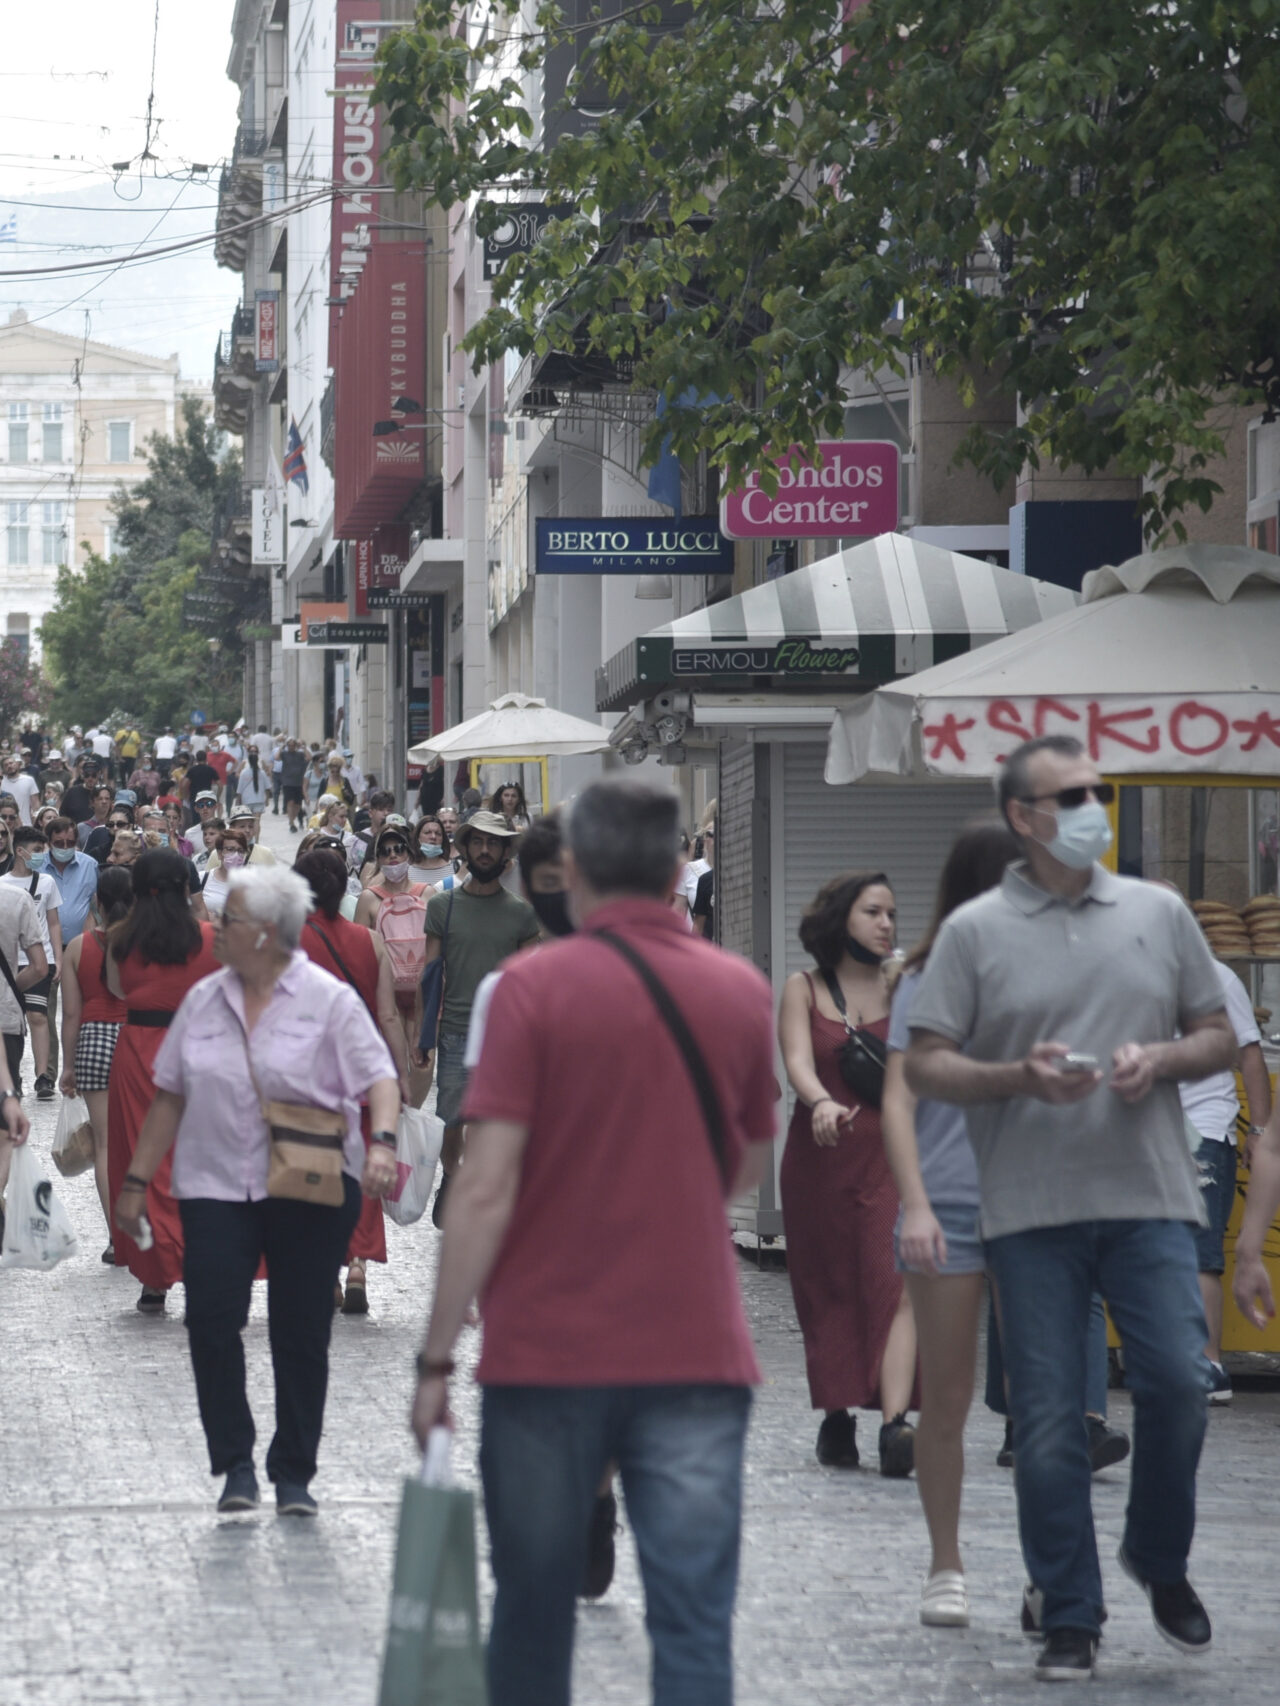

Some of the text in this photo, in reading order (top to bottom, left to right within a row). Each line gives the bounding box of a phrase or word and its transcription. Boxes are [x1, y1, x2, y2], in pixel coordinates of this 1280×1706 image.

[390, 281, 407, 420] UKYBUDDHA
[741, 488, 869, 525] Center
[548, 531, 720, 551] BERTO LUCCI
[592, 556, 677, 566] MILANO
[675, 641, 856, 671] ERMOU Flower
